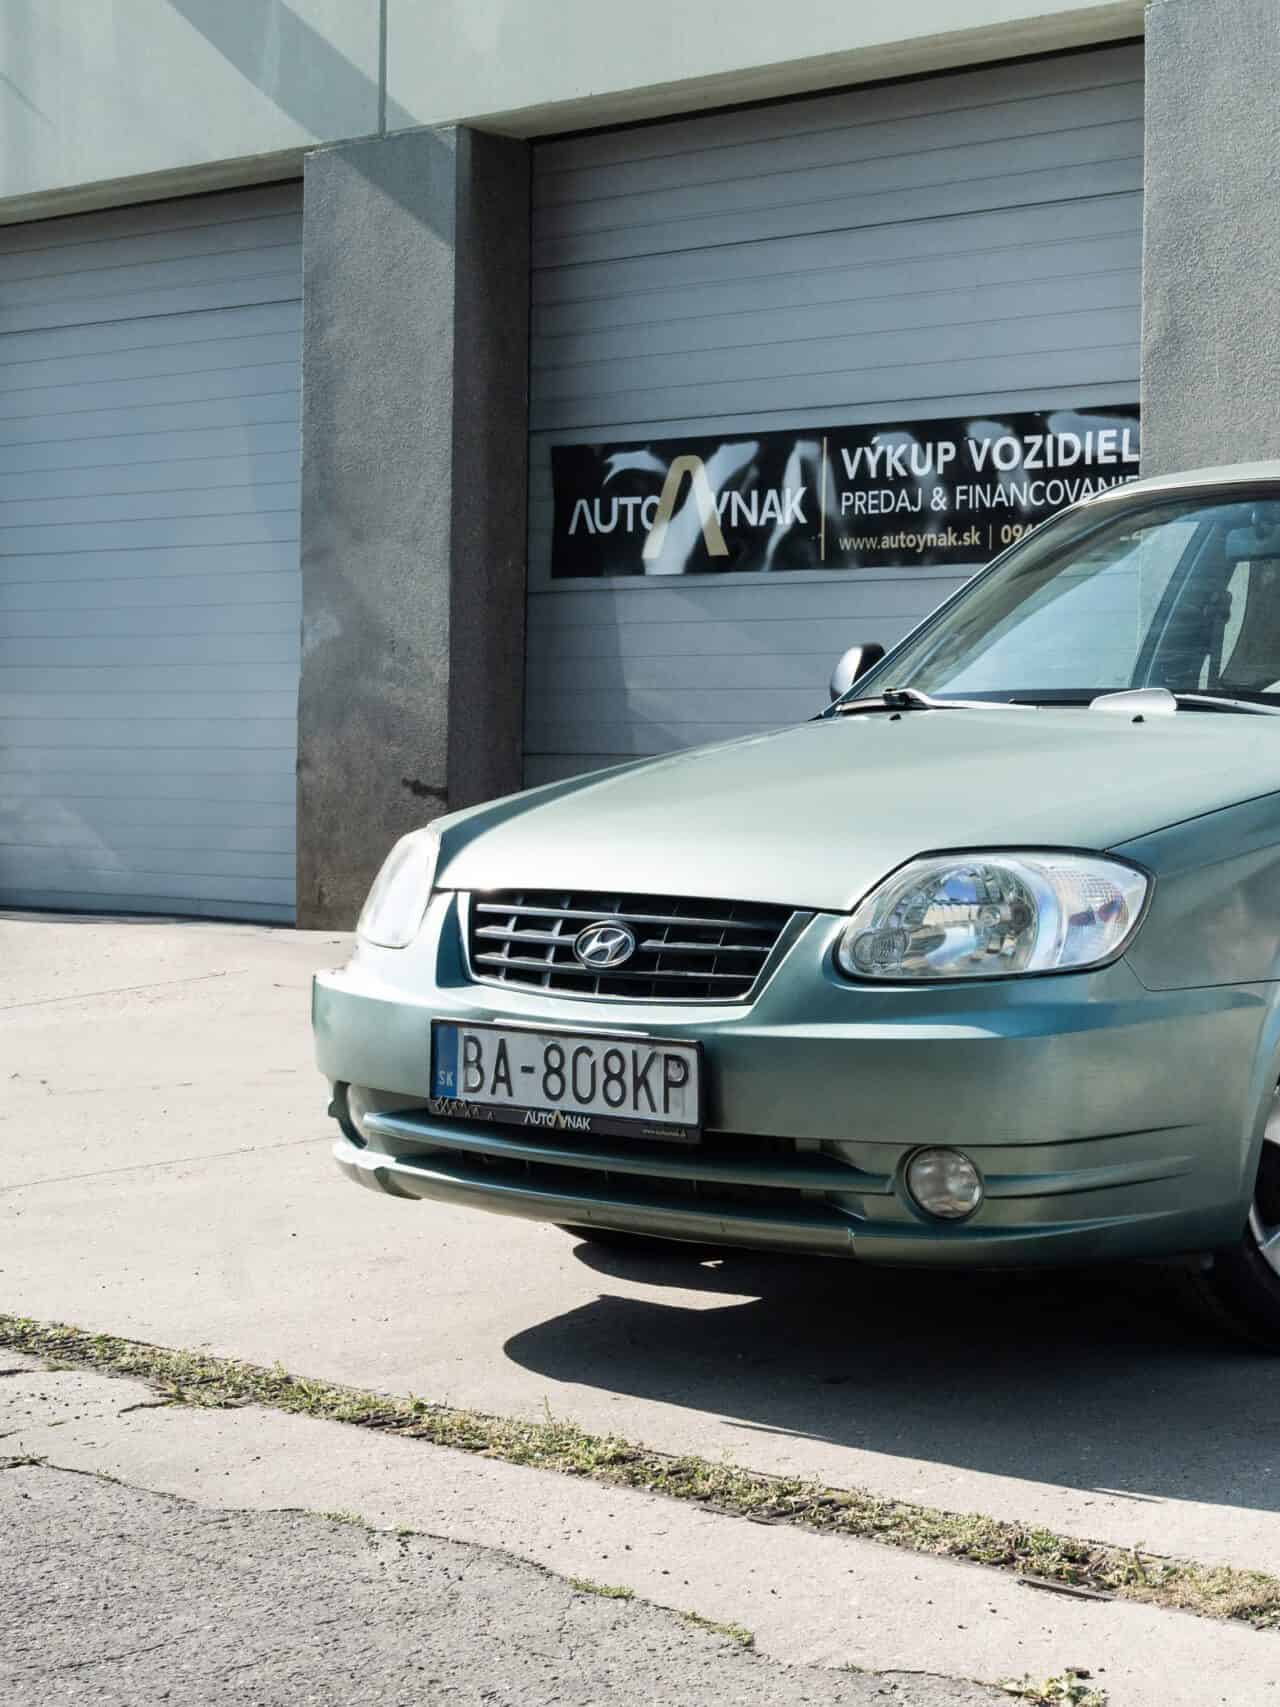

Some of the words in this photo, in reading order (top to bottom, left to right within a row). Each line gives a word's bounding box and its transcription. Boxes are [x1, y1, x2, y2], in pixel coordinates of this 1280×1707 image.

[840, 436, 954, 480] VÝKUP
[968, 428, 1140, 472] VOZIDIEL
[841, 487, 922, 515] PREDAJ
[930, 486, 947, 511] &
[955, 474, 1139, 510] FINANCOVA
[838, 525, 981, 552] www.autoynak.sk
[438, 1070, 454, 1088] SK
[463, 1034, 689, 1114] BA-808KP
